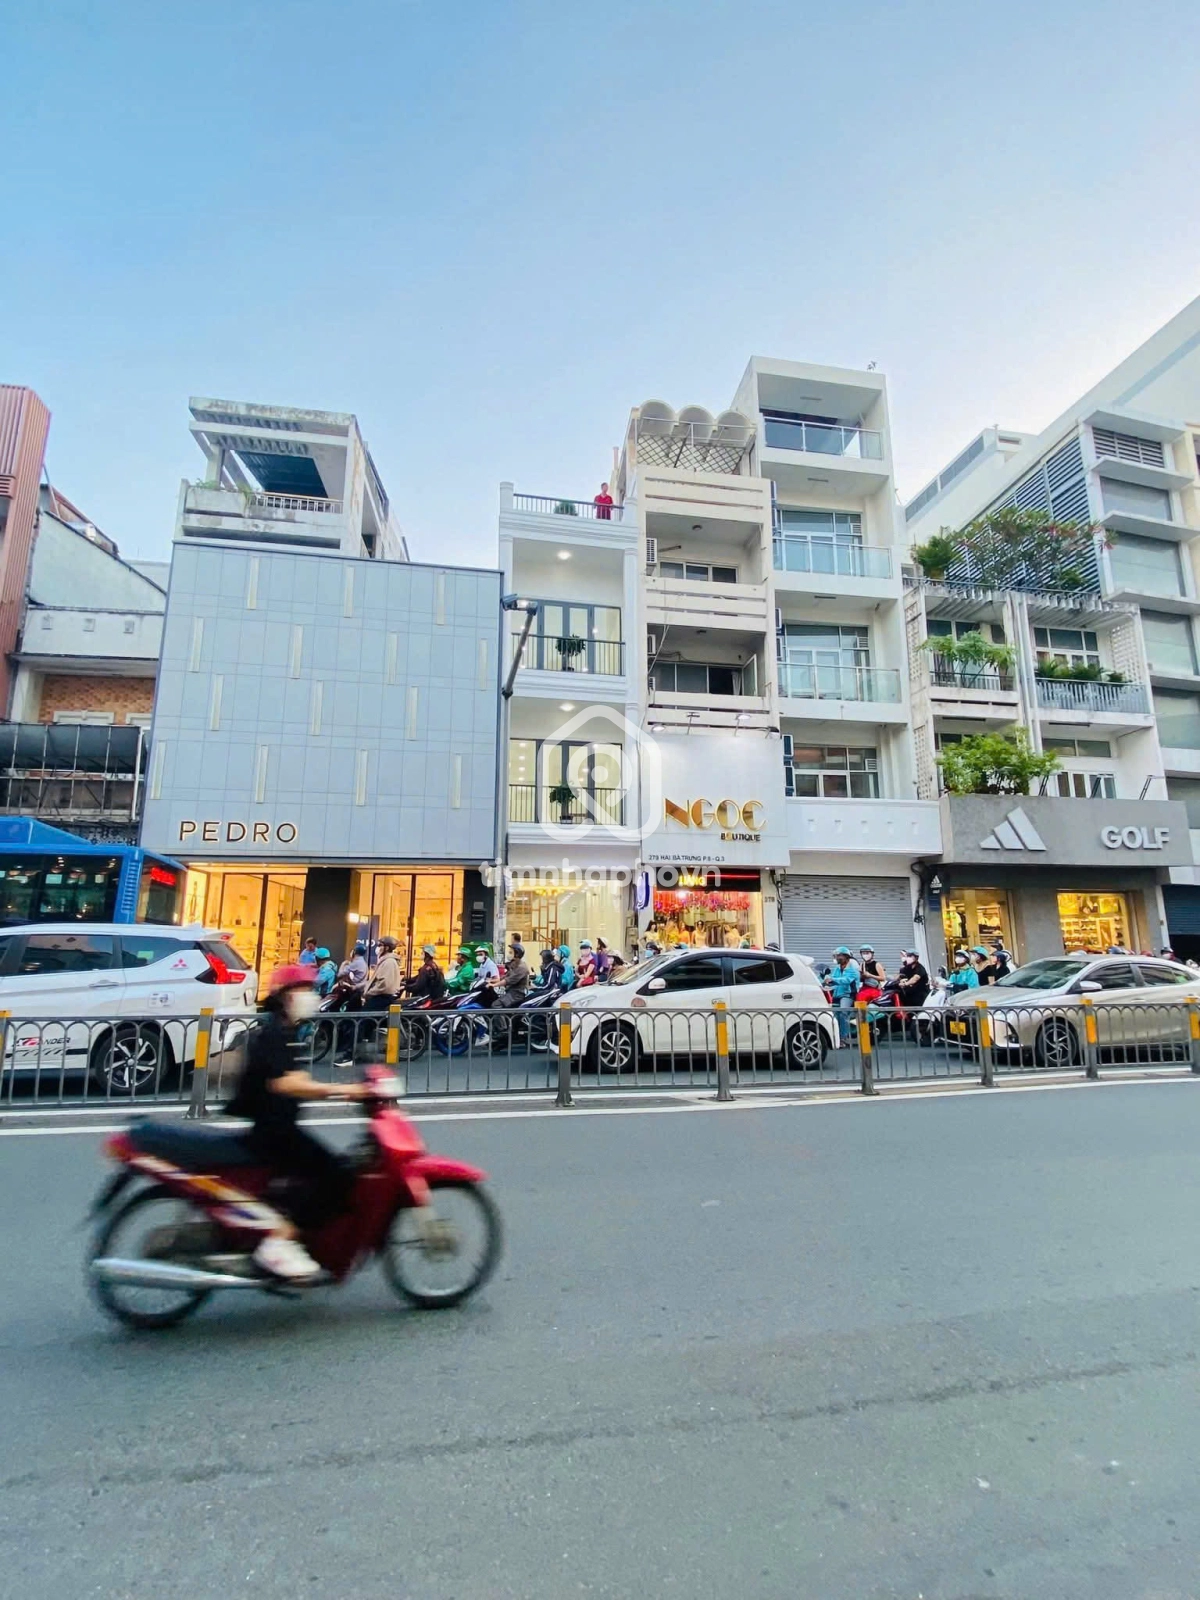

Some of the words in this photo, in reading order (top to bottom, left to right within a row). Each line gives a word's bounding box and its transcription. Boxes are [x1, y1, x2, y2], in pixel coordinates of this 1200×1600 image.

[179, 820, 297, 843] PEDRO
[720, 832, 760, 842] BOUTIQUE
[1101, 825, 1169, 849] GOLF
